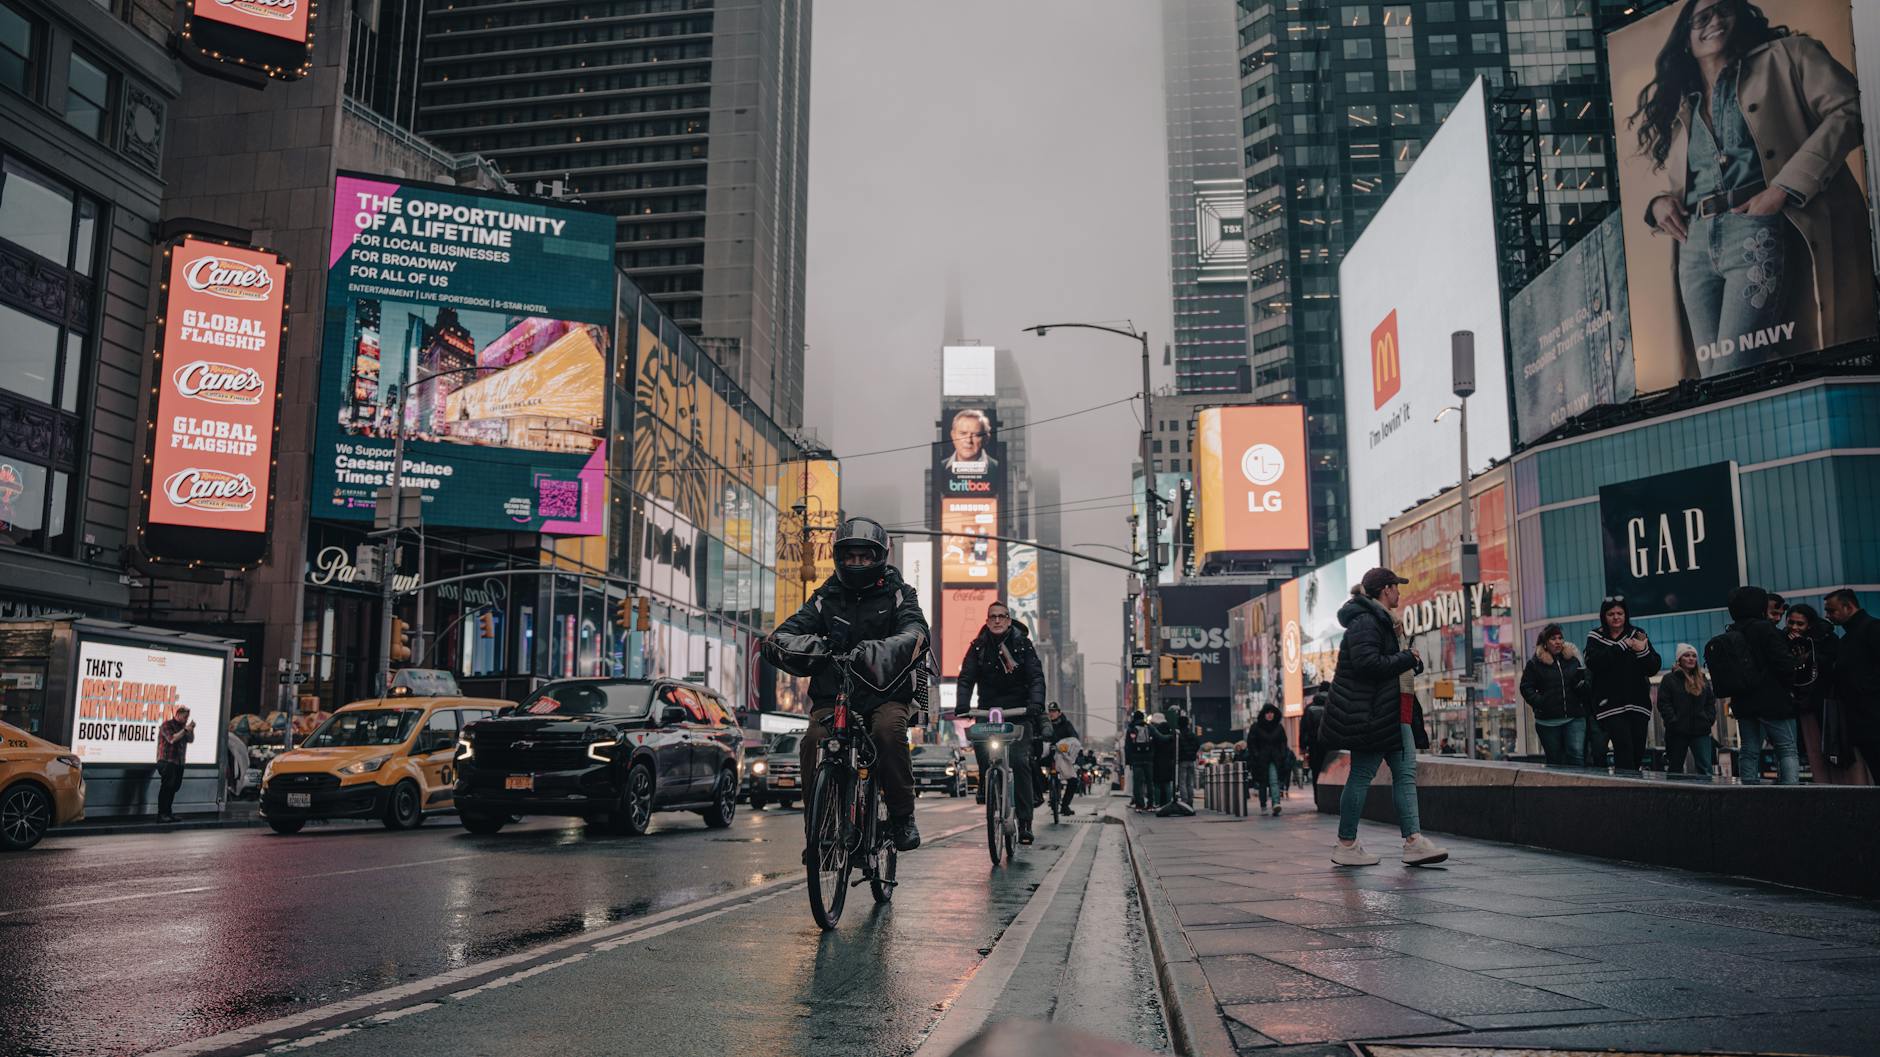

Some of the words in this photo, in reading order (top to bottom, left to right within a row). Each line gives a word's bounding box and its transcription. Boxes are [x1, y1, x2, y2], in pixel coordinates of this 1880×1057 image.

[356, 192, 402, 214] THE
[407, 200, 566, 236] OPPORTUNITY
[355, 212, 386, 231] OF
[390, 216, 408, 234] A
[412, 219, 512, 248] LIFETIME
[1222, 225, 1242, 234] TSX
[352, 249, 379, 262] FOR
[382, 252, 457, 272] BROADWAY
[353, 234, 381, 248] FOR
[383, 236, 427, 253] LOCAL
[430, 242, 510, 264] BUSINESSES
[189, 256, 271, 290] Cane's
[350, 265, 378, 278] FOR
[380, 268, 405, 283] ALL
[408, 272, 426, 285] OF
[430, 275, 448, 288] US
[348, 284, 415, 298] ENTERTAINMENT
[420, 291, 438, 302] LIVE
[438, 293, 490, 308] SPORTSBOOK
[496, 300, 522, 312] 5-STAR
[522, 302, 548, 314] HOTEL
[182, 310, 266, 338] GLOBAL
[1537, 326, 1560, 349] There
[1561, 317, 1574, 334] We
[180, 327, 266, 351] FLAGSHIP
[1698, 339, 1735, 362] OLD
[1739, 322, 1796, 352] NAVY
[1524, 347, 1557, 380] Stopping
[1557, 328, 1585, 355] Traffic
[179, 361, 262, 396] Cane's
[1551, 408, 1565, 426] OLD
[1567, 393, 1590, 417] NAVY
[173, 416, 257, 442] GLOBAL
[1369, 430, 1382, 450] i'm
[1404, 402, 1412, 424] it
[171, 434, 256, 456] FLAGSHIP
[336, 443, 353, 454] We
[355, 445, 397, 458] Support
[335, 455, 397, 472] Caesars
[402, 460, 453, 476] Palace
[336, 469, 383, 486] Times
[170, 468, 254, 504] Cane's
[949, 480, 990, 492] britbox
[950, 504, 990, 512] SAMSUNG
[1248, 491, 1282, 512] LG
[1628, 508, 1706, 578] GAP
[311, 546, 420, 595] Parunt
[1403, 602, 1434, 636] OLD
[86, 658, 123, 678] THAT'S
[148, 655, 166, 663] boost
[78, 722, 117, 741] BOOST
[118, 724, 156, 742] MOBILE
